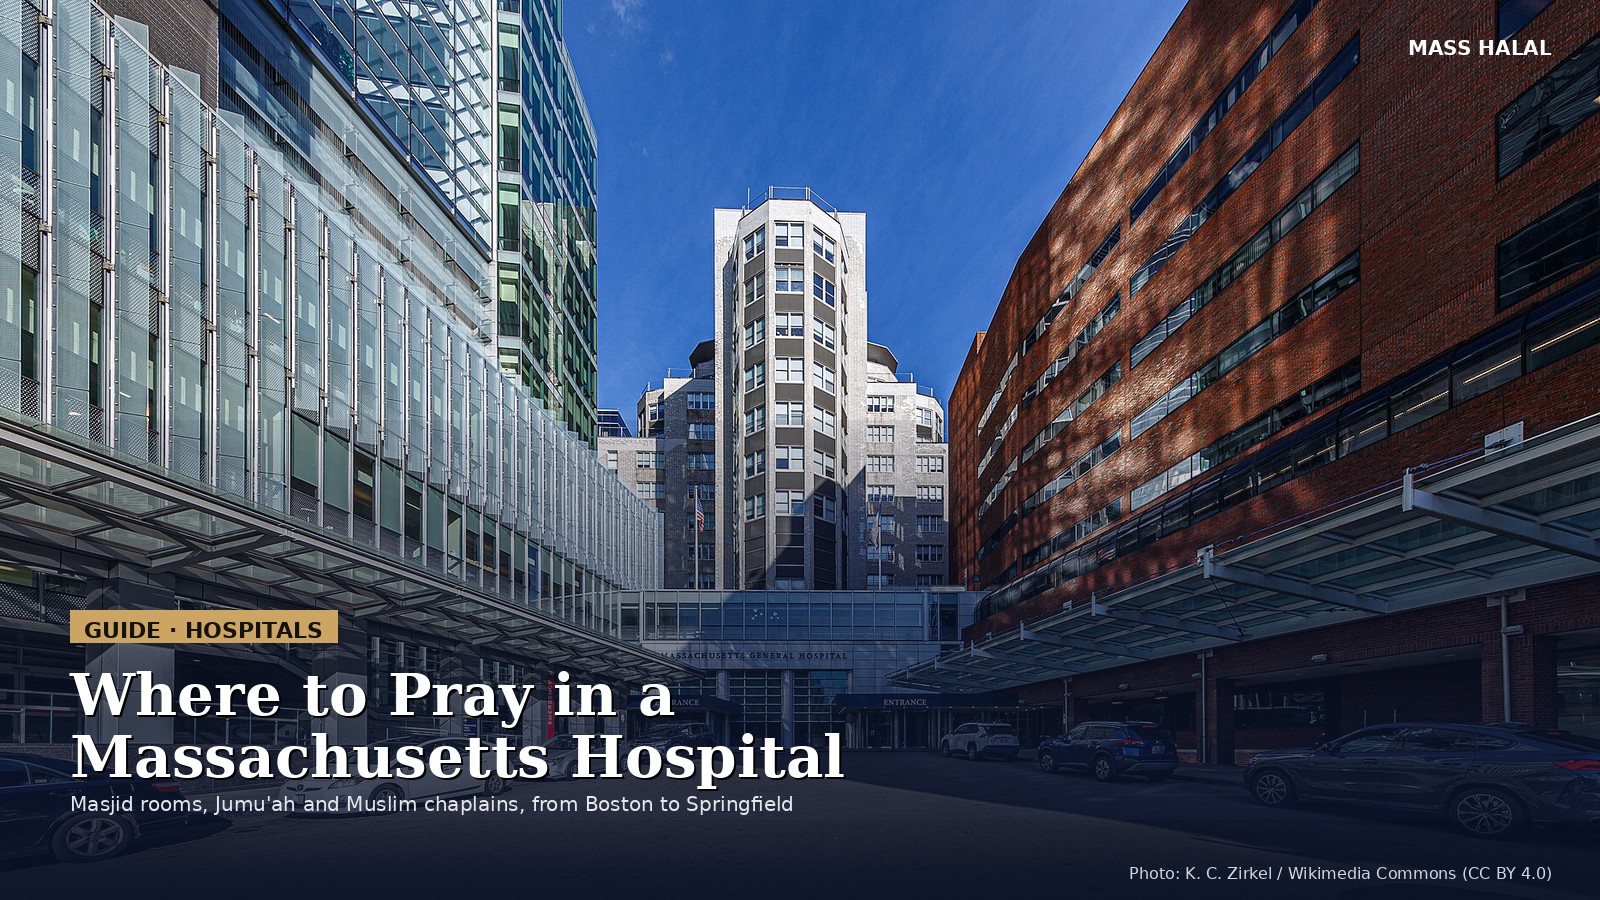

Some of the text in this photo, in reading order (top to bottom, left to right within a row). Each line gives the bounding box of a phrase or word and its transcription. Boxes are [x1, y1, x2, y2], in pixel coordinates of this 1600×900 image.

[749, 651, 794, 660] GENERAL
[798, 651, 848, 660] HOSPITAL
[883, 698, 927, 706] ENTRANCE
